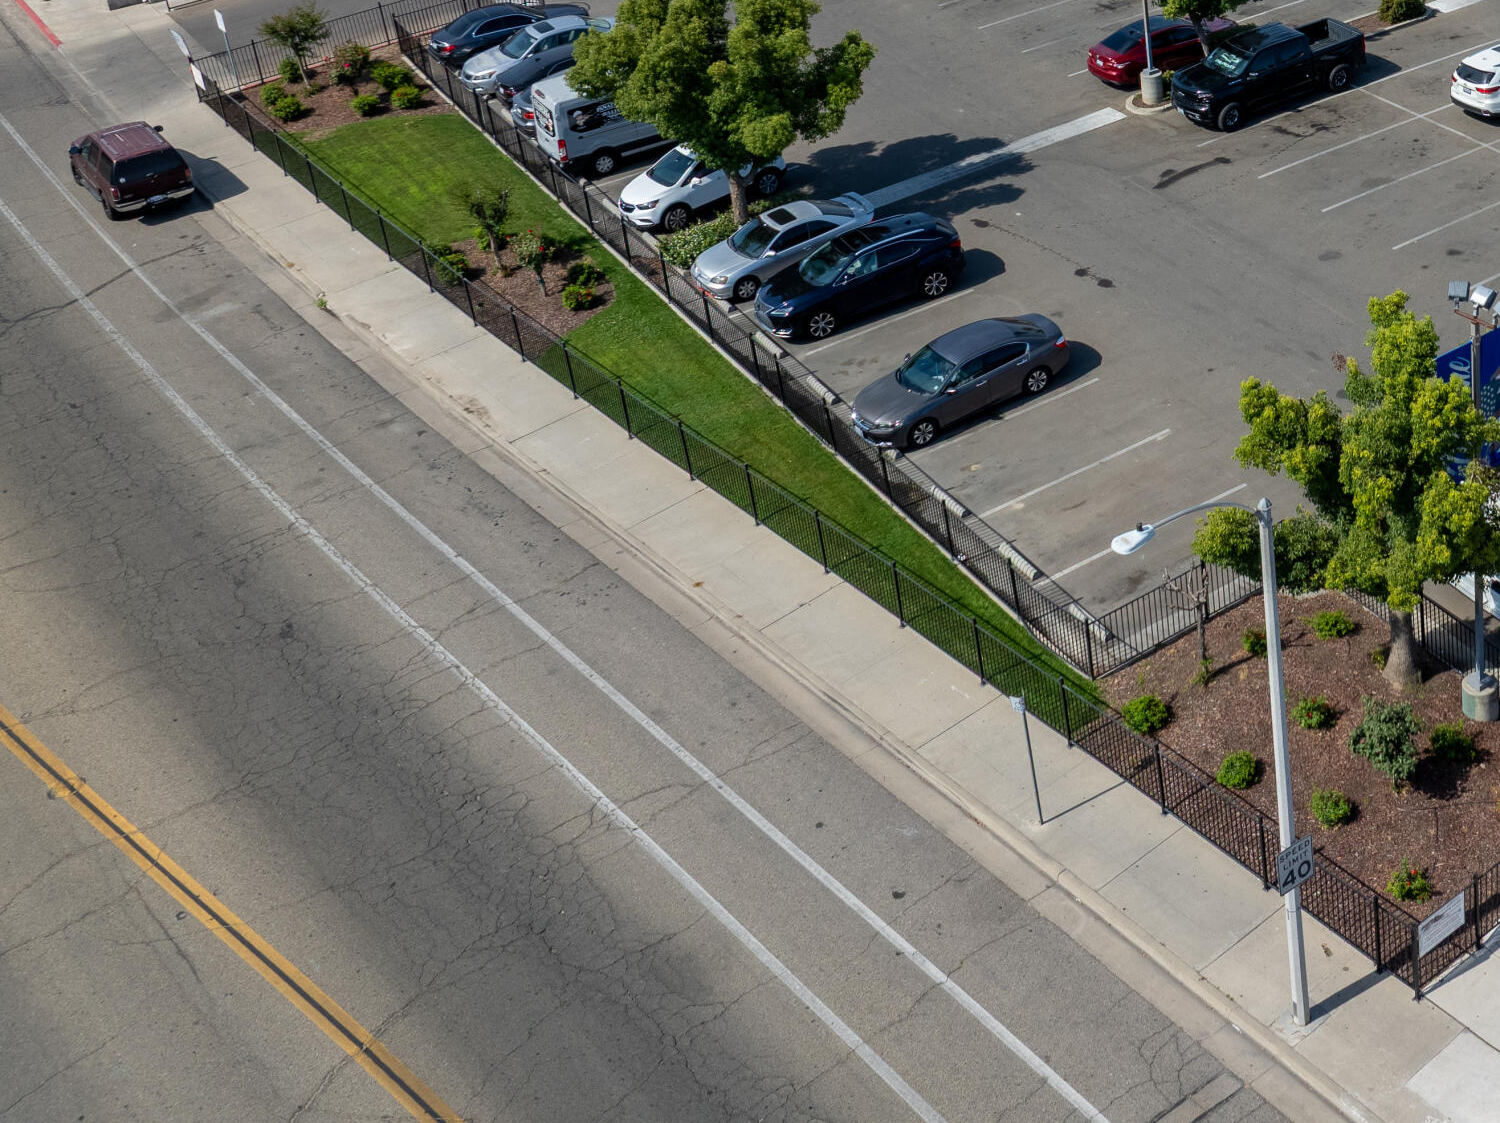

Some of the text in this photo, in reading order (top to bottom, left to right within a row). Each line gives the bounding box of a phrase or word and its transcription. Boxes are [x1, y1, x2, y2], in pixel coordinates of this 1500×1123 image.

[1280, 840, 1310, 864] SPEED
[1283, 849, 1308, 871] LIMIT
[1282, 860, 1311, 887] 40
